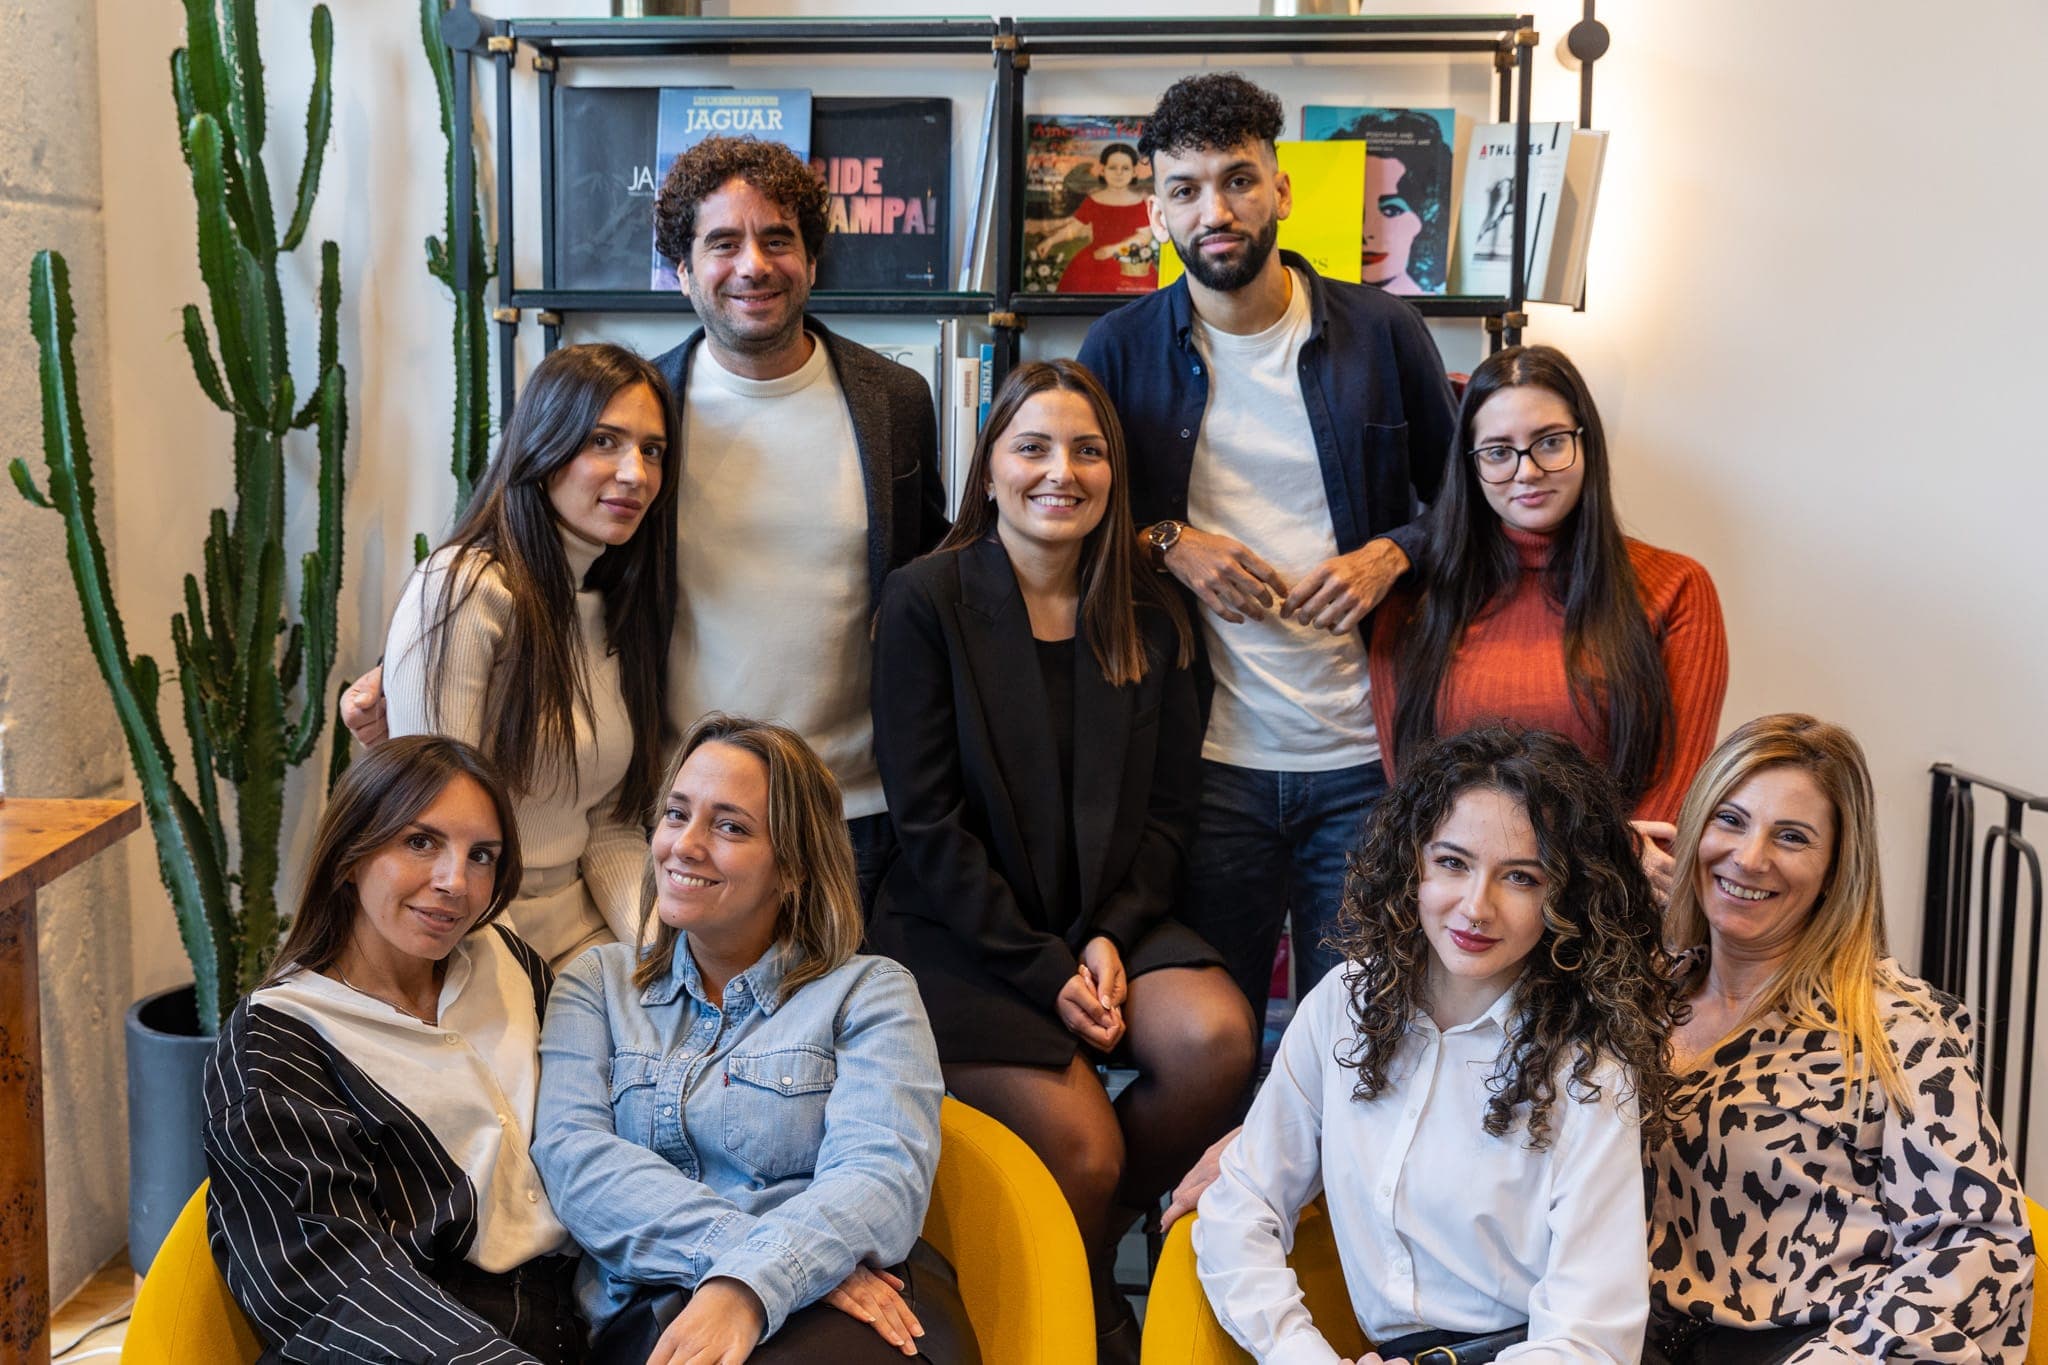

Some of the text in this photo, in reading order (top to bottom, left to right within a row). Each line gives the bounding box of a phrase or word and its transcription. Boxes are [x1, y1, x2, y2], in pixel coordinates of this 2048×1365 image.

[684, 108, 783, 134] JAGUAR
[1115, 120, 1143, 138] Fol
[1478, 144, 1544, 157] ATHLES
[826, 197, 936, 234] AMPA!
[983, 360, 992, 404] VENISE
